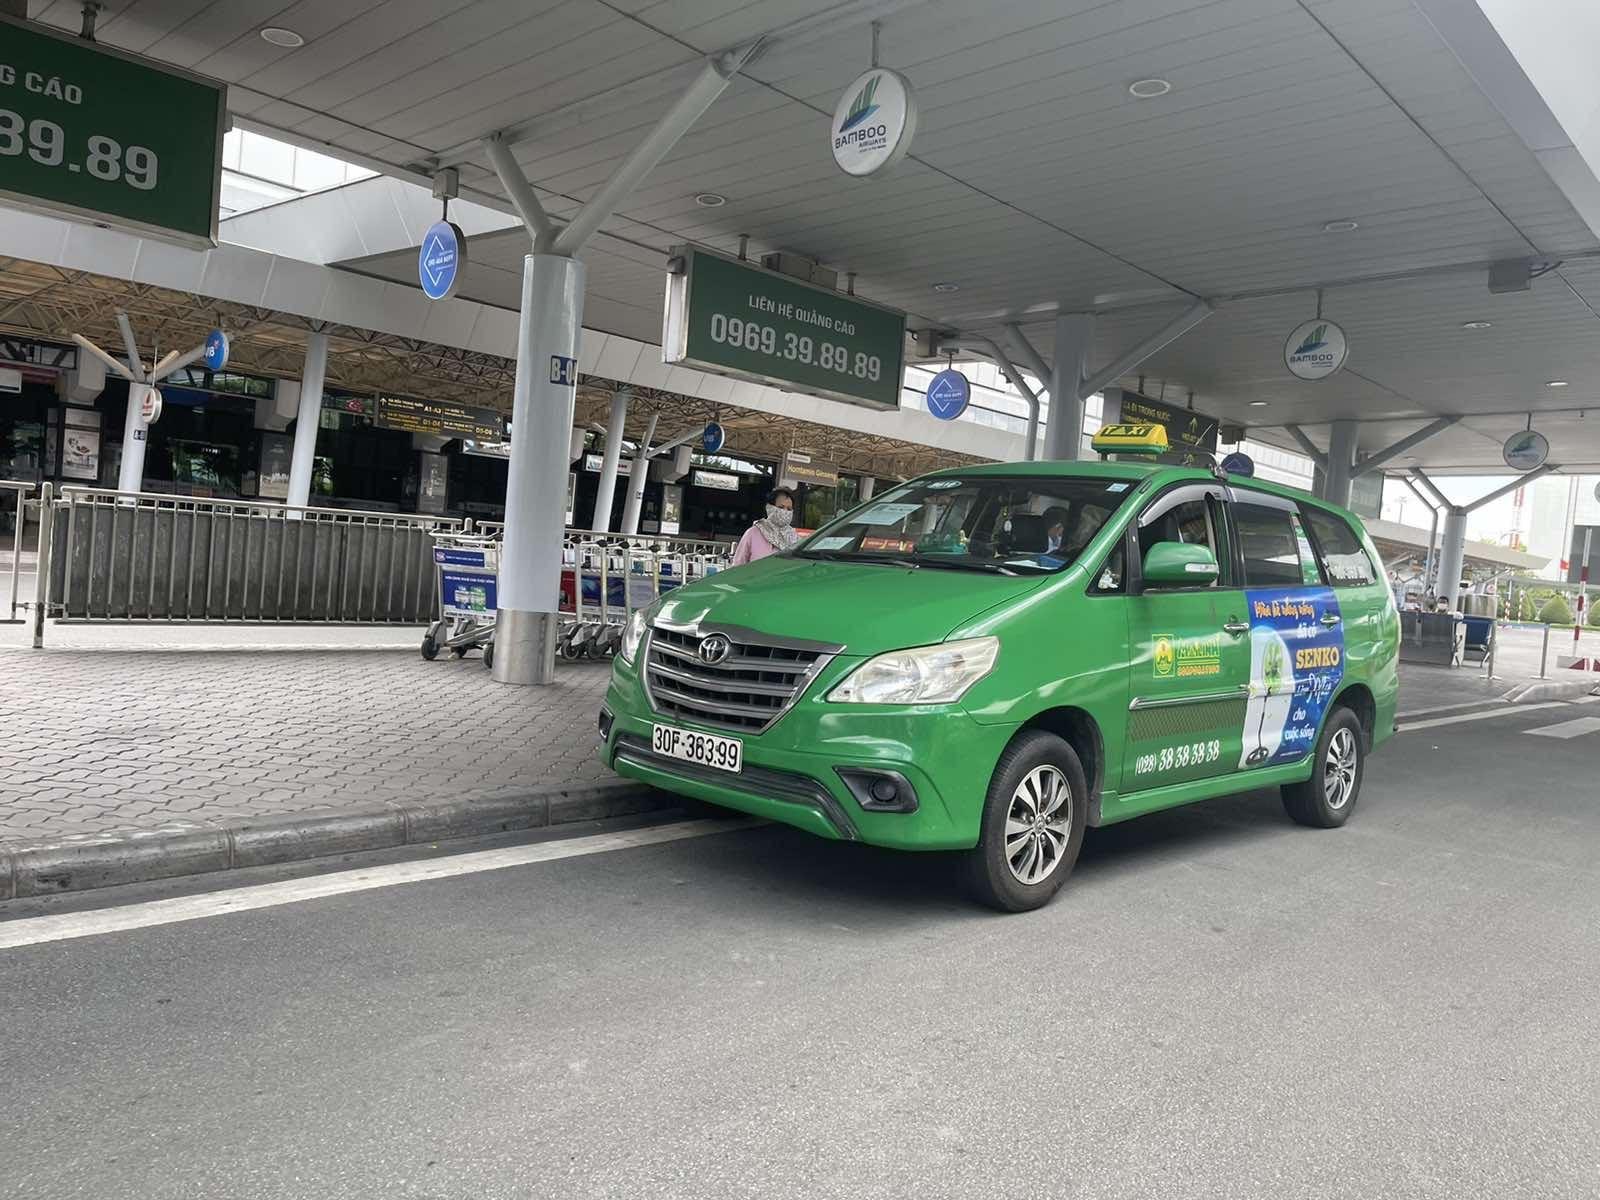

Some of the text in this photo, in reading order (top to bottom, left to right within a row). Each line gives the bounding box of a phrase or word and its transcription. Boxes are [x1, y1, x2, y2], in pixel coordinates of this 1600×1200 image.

[25, 72, 83, 105] CÁO
[834, 124, 887, 149] BAMBOO
[749, 295, 856, 336] LIÊN HỆ QUẢNG CÁO
[710, 313, 881, 382] 0969.39.89.89
[1103, 425, 1148, 436] TAXI
[1295, 646, 1340, 669] SENKO
[1292, 707, 1307, 721] cho
[1284, 723, 1315, 742] cuộc sống
[1135, 739, 1220, 776] (028) 38 38 38 38
